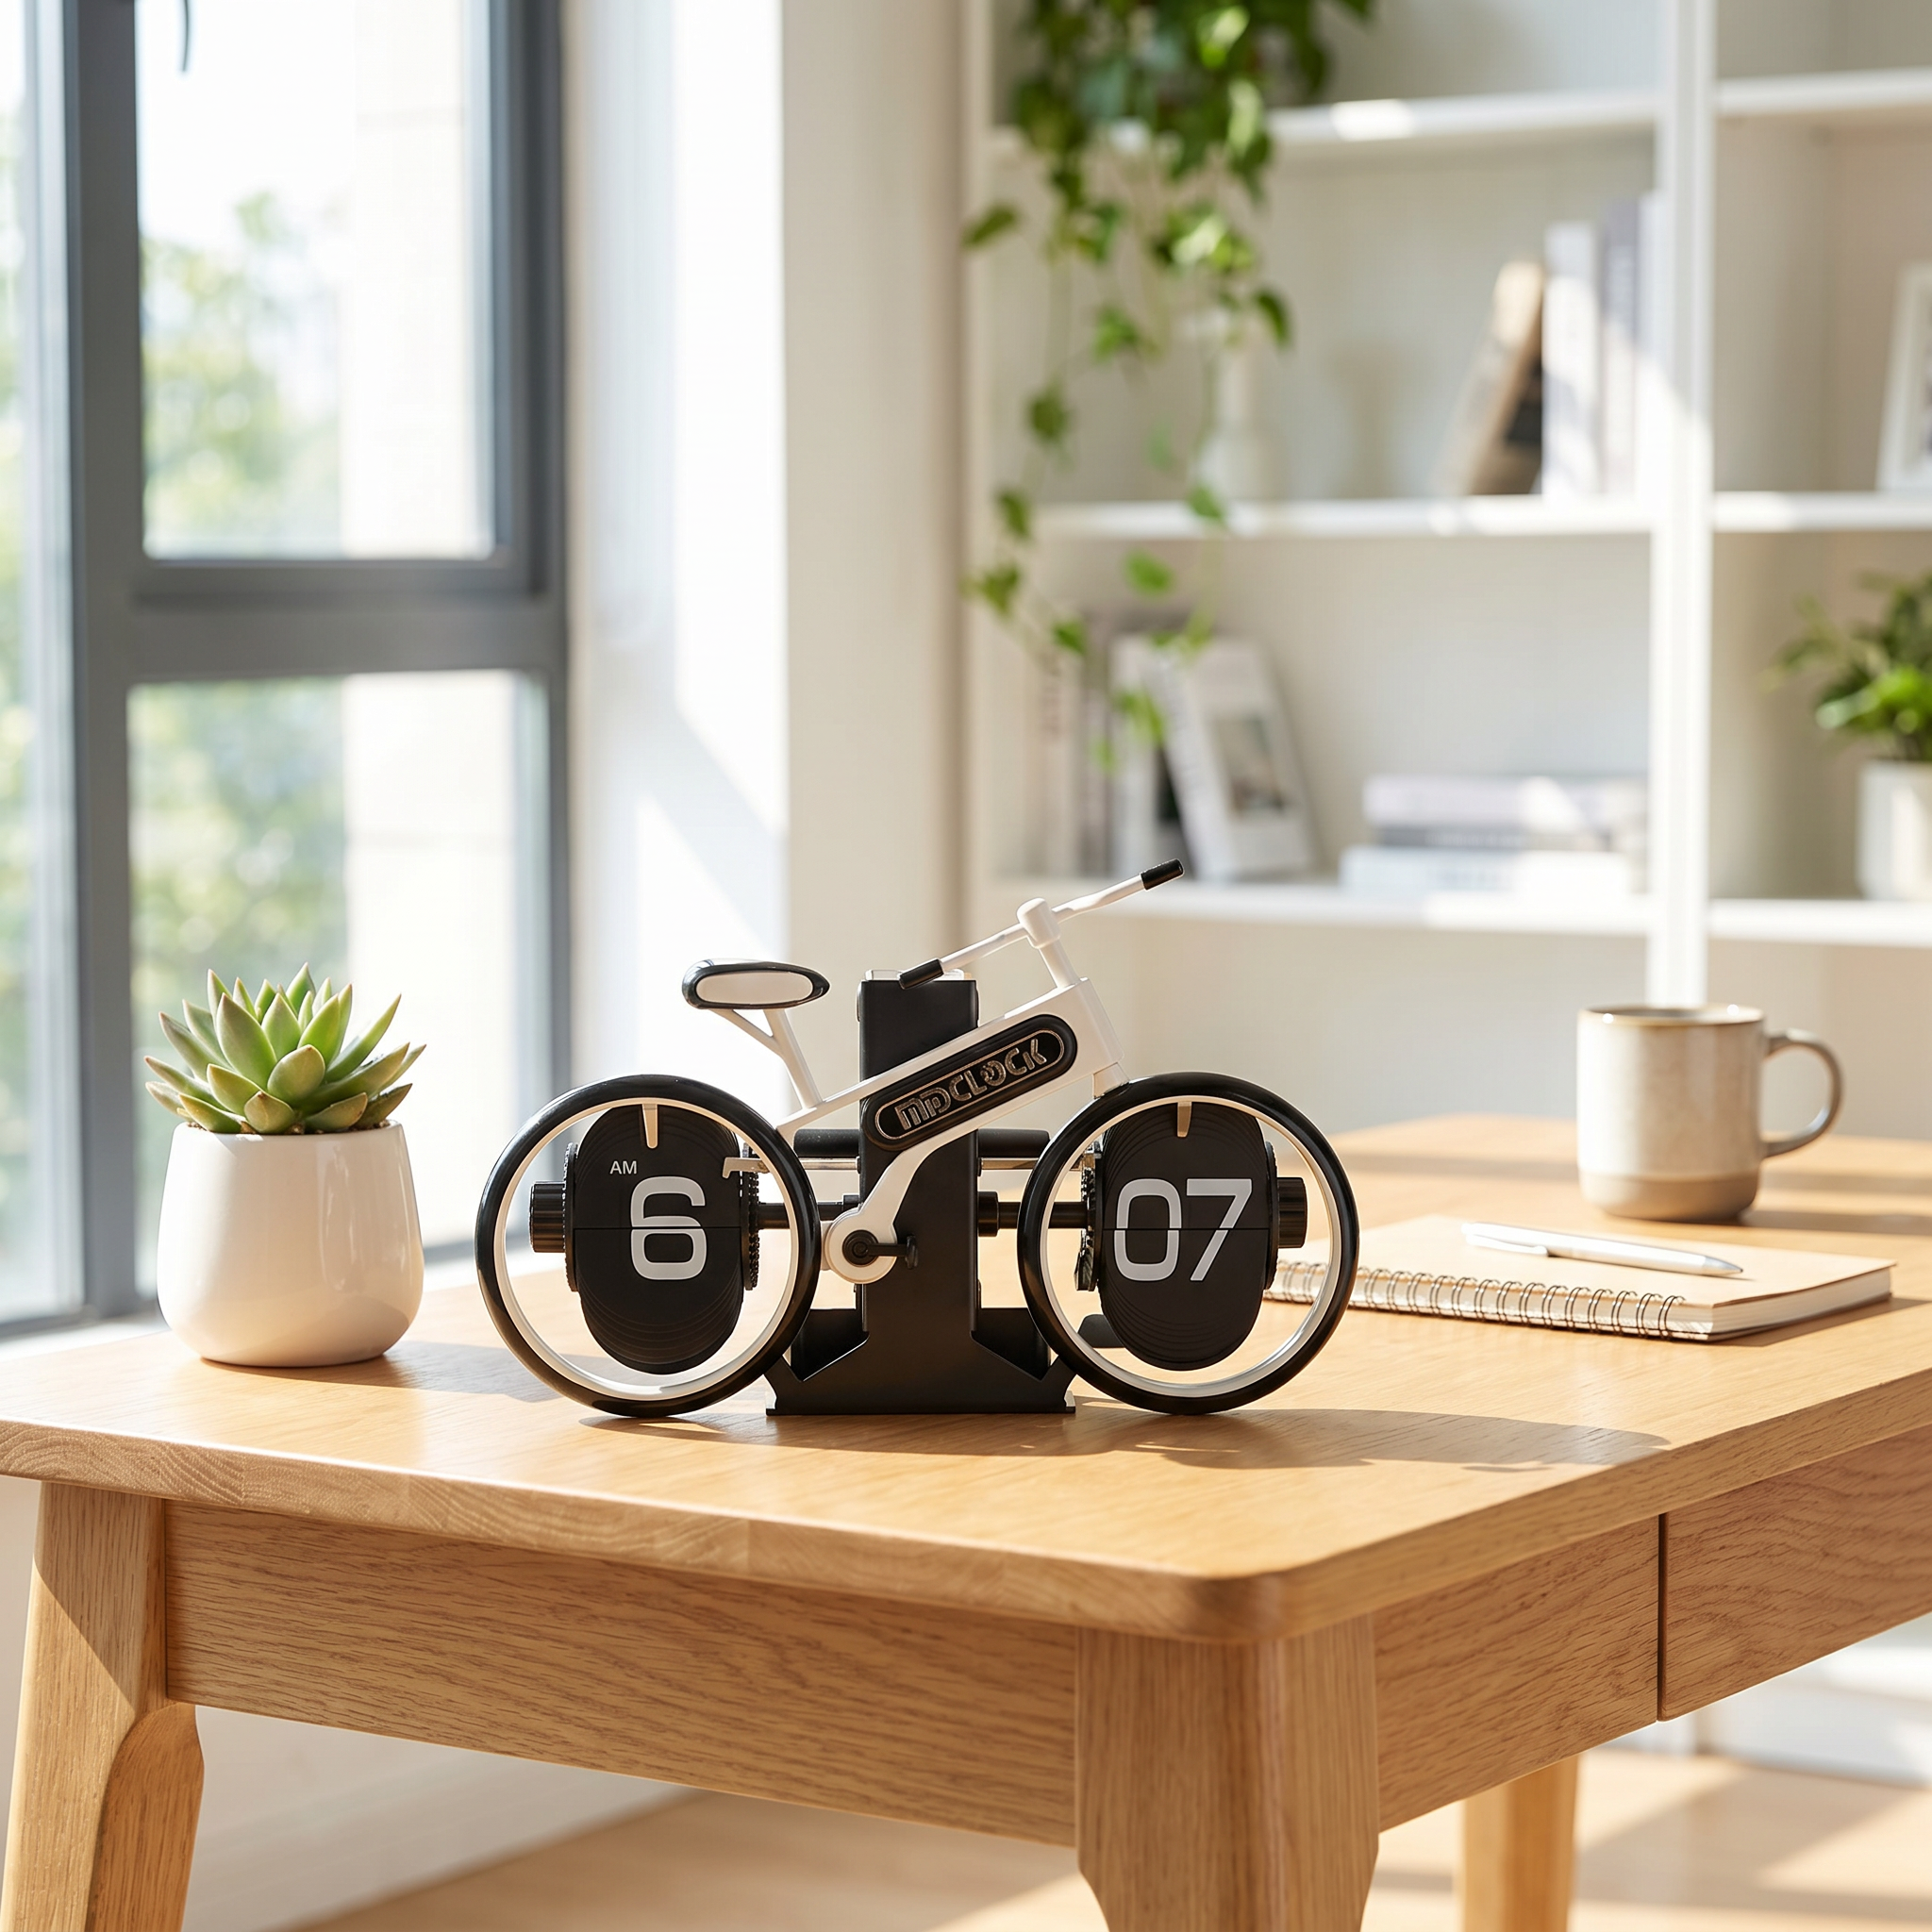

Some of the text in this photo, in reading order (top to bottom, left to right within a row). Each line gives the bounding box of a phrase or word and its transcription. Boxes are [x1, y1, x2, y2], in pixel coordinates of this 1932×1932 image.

[609, 1160, 638, 1174] AM
[630, 1175, 708, 1280] 6
[1114, 1178, 1253, 1281] 07
